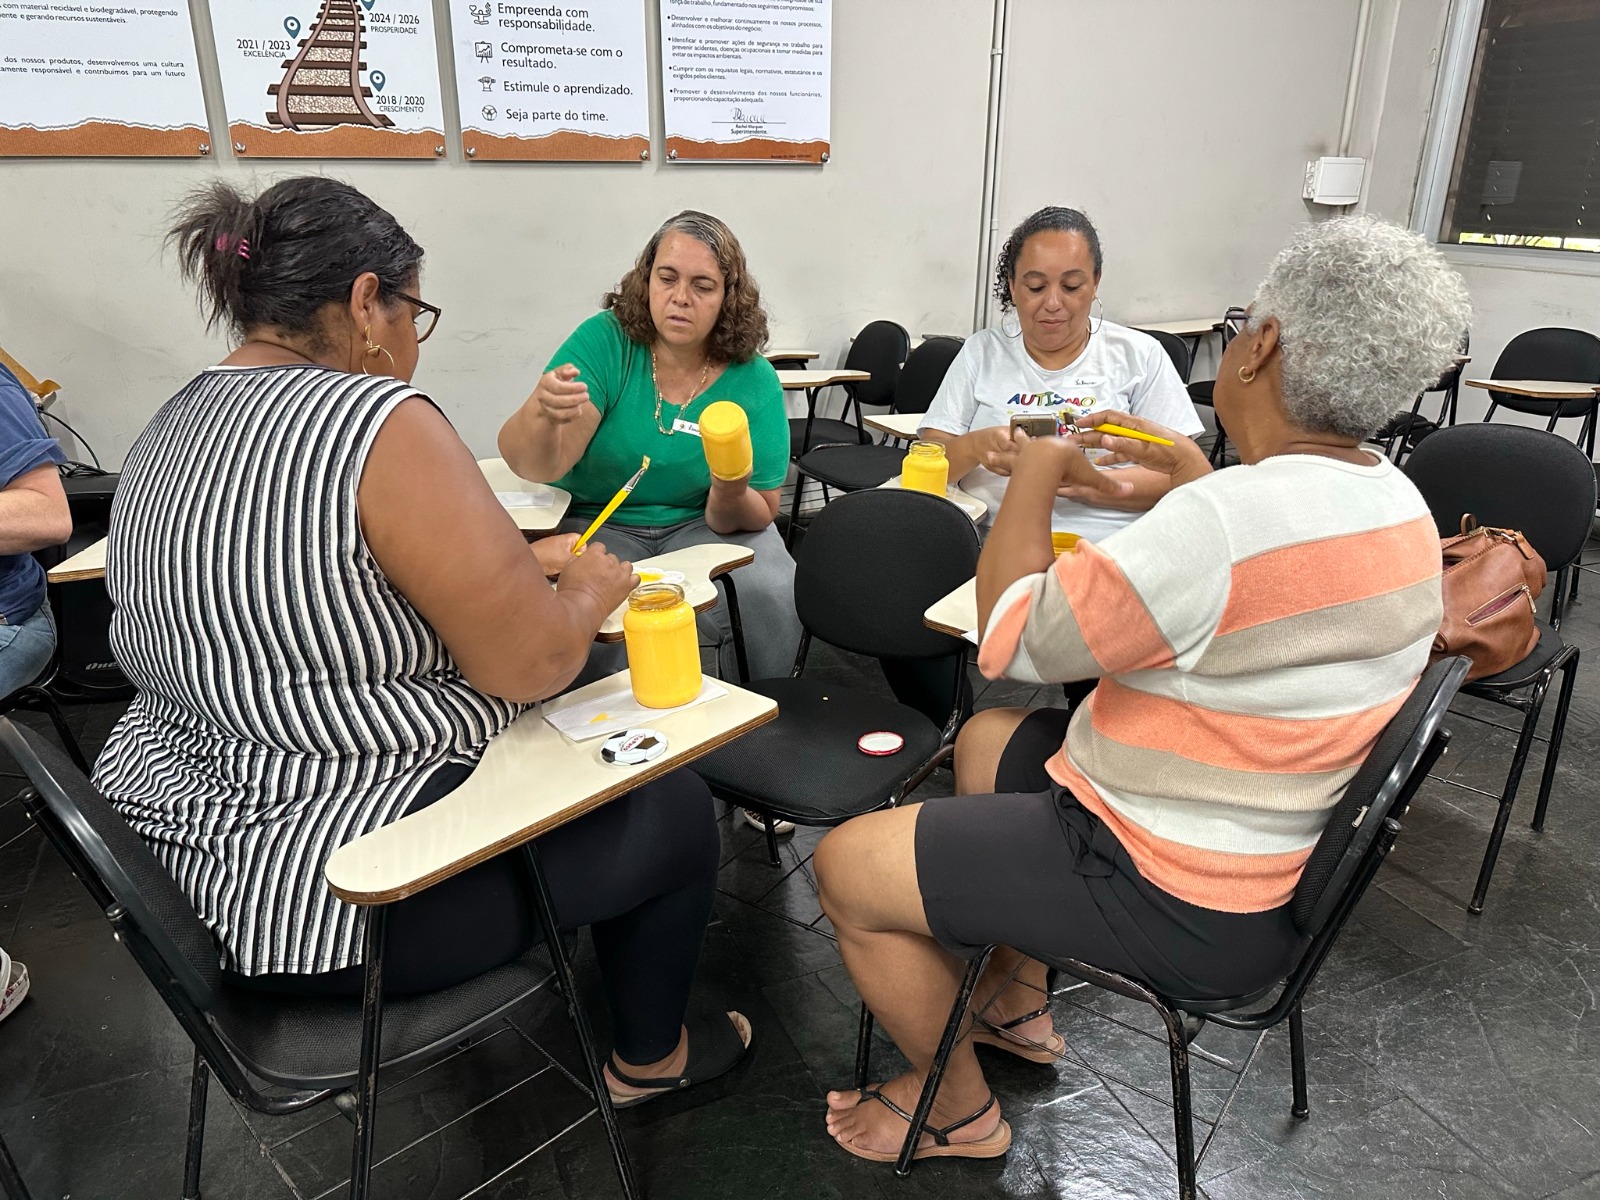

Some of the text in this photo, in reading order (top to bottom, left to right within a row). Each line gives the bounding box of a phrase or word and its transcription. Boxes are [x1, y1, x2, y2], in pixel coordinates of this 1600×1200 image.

[90, 6, 138, 16] biodegradável,
[498, 3, 588, 18] Empreenda com
[370, 13, 390, 23] 2024
[399, 14, 419, 24] 2026
[371, 26, 417, 34] PROSPERIDADE
[499, 18, 595, 32] responsabilidade.
[237, 39, 259, 49] 2021
[269, 40, 290, 50] 2023
[501, 42, 623, 57] Comprometa-se com o
[243, 50, 286, 58] EXCELÊNCIA
[502, 57, 557, 69] resultado.
[504, 81, 633, 96] Estimule o aprendizado.
[376, 95, 396, 105] 2018
[405, 96, 425, 106] 2020
[506, 109, 608, 122] Seja parte do time.
[1007, 391, 1096, 407] AUTISMO
